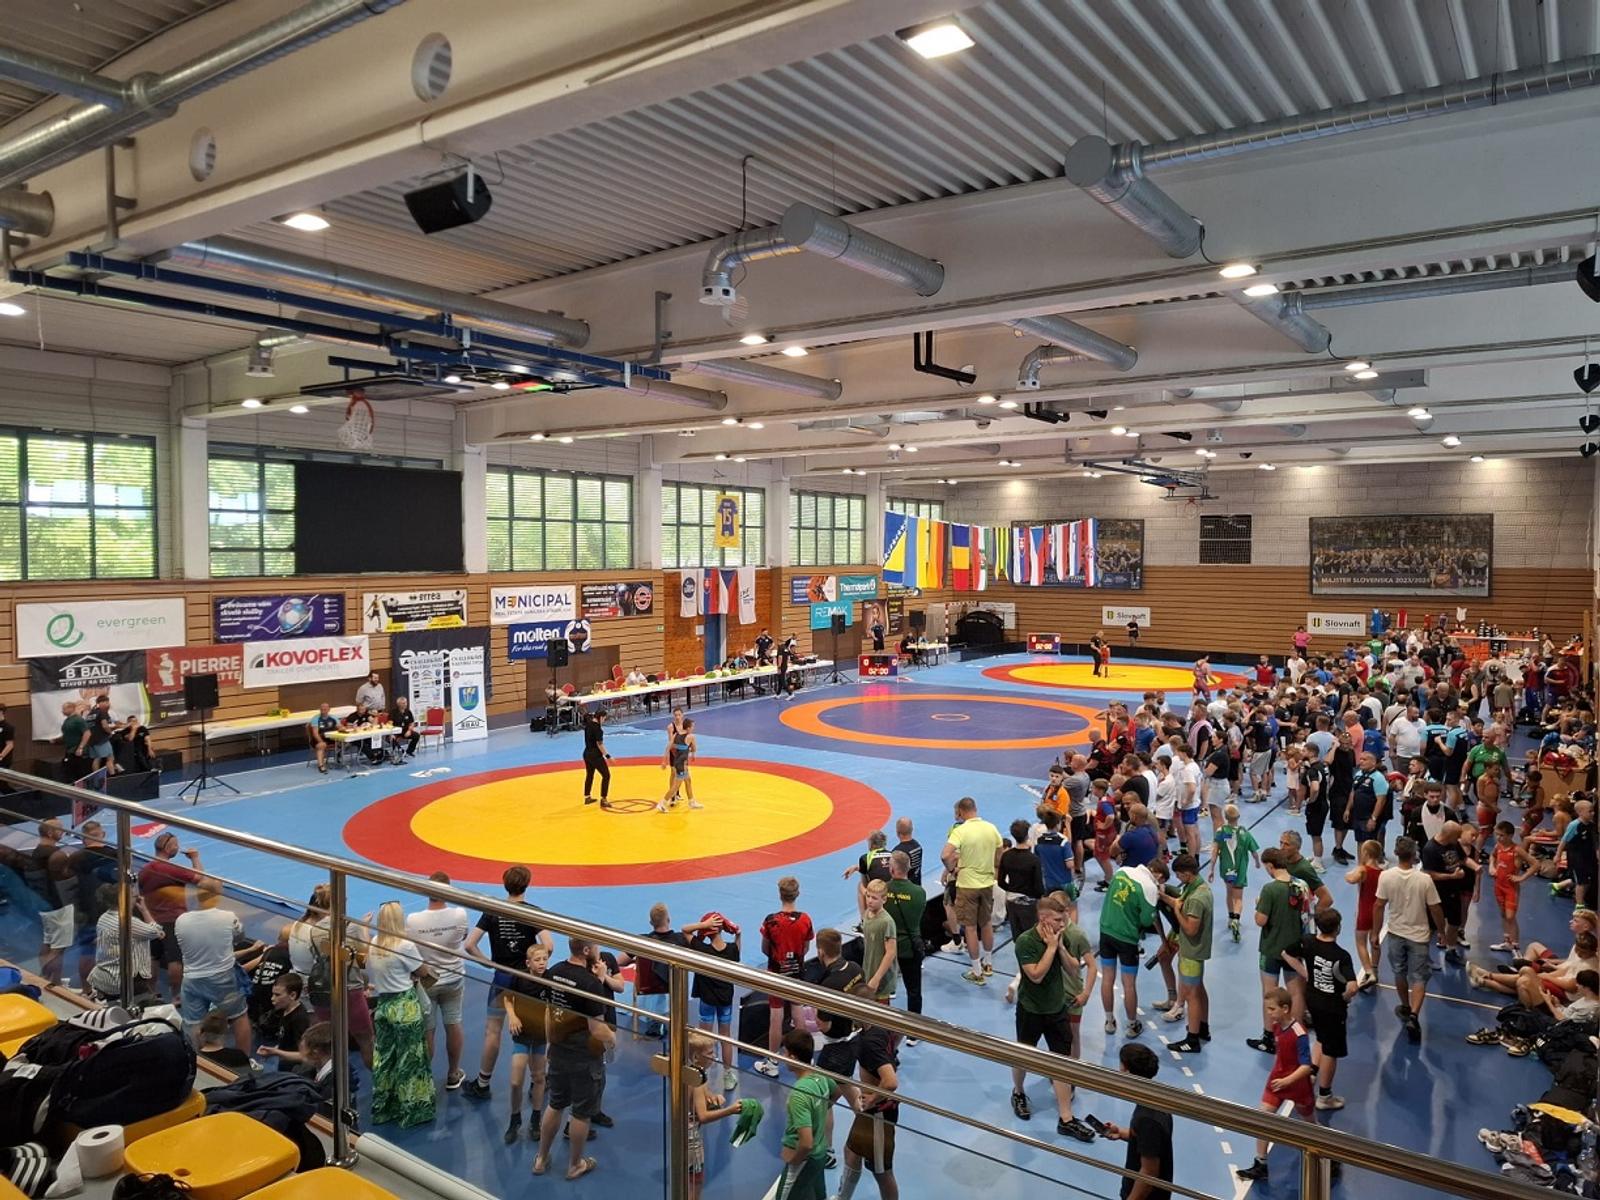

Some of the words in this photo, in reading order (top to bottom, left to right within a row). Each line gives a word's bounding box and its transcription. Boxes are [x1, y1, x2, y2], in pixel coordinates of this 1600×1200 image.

[96, 616, 167, 629] evergreen
[1325, 620, 1361, 628] Slovnaft
[514, 628, 560, 643] molten
[266, 646, 363, 668] KOVOFLEX
[81, 665, 111, 678] BAU
[180, 656, 241, 675] PIERRE
